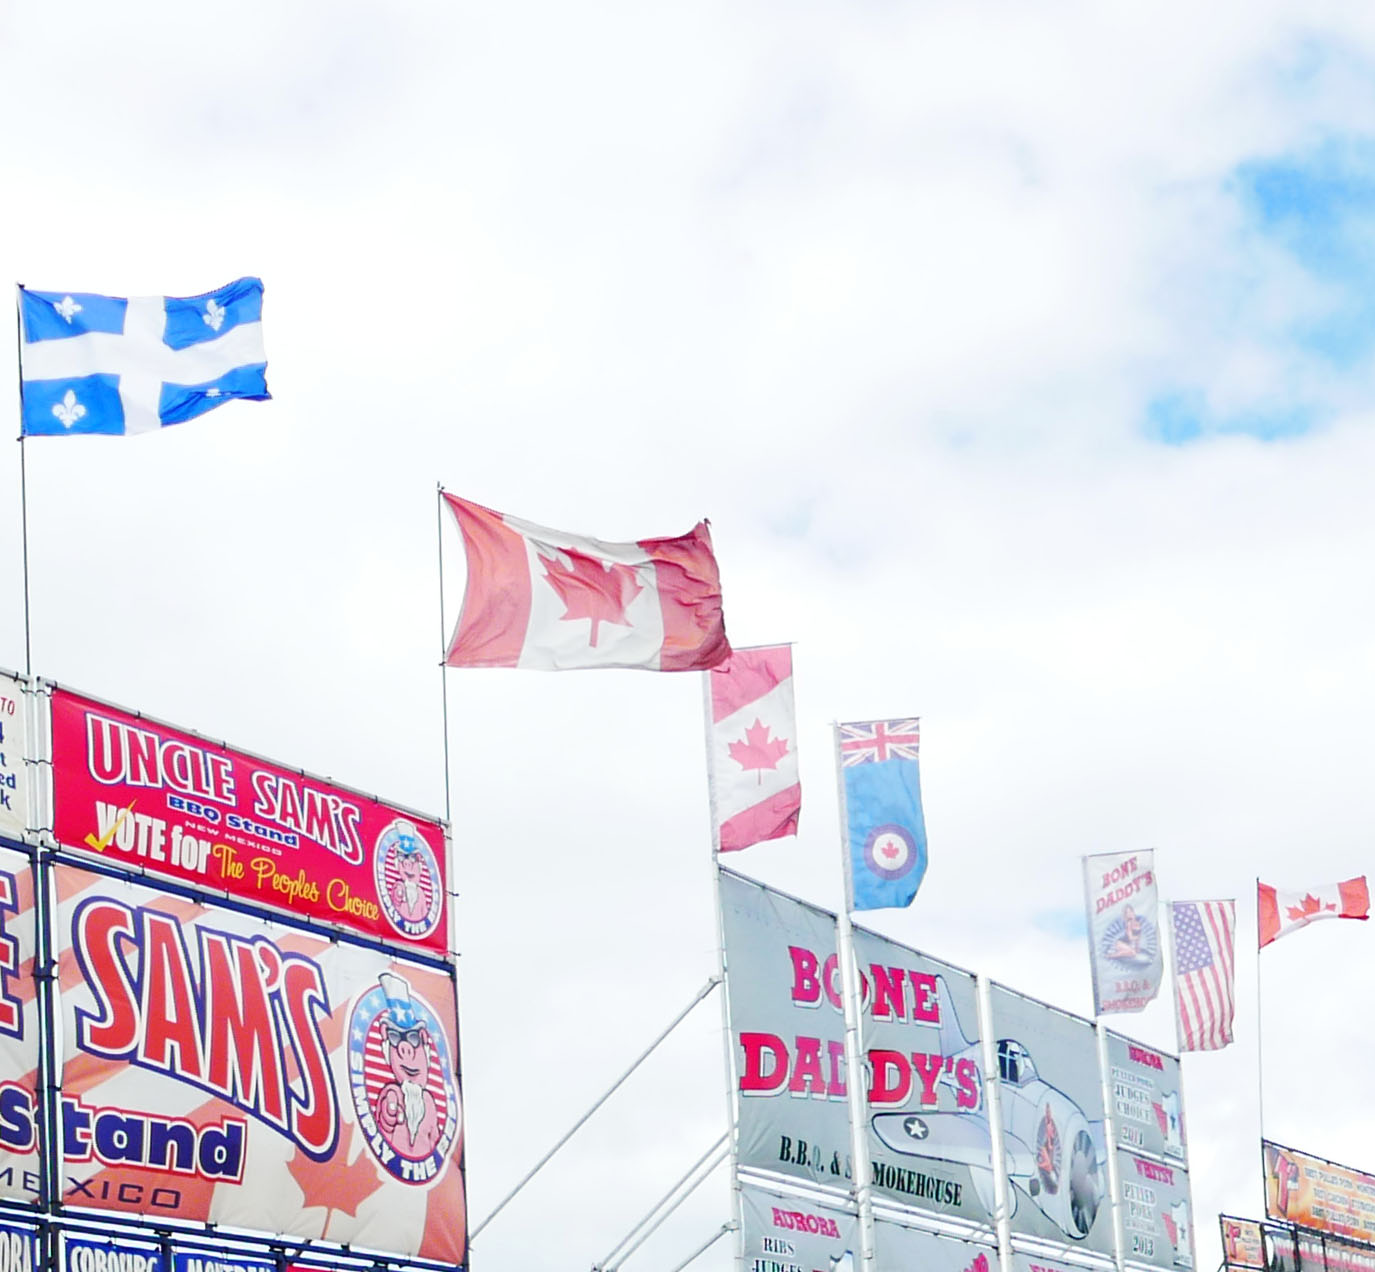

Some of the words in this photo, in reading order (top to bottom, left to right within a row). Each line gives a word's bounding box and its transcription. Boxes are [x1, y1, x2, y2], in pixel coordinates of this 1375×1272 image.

[85, 711, 237, 807] UNCLE
[250, 769, 366, 867] SAM'S
[167, 793, 222, 826] BBQ
[184, 820, 220, 837] NEW
[224, 832, 283, 857] MEXICO
[96, 801, 166, 862] VOTE
[171, 824, 212, 874] for
[250, 857, 320, 904] Peoples
[326, 878, 380, 921] Choice
[1101, 855, 1138, 890] BONE
[1095, 869, 1154, 915] DADDY'S
[788, 944, 942, 1028] BONE
[72, 894, 341, 1165] SAM'S
[738, 1030, 983, 1113] DADDY'S
[400, 1156, 439, 1182] THE
[829, 1148, 841, 1177] &
[771, 1206, 841, 1239] AURORA
[763, 1237, 796, 1257] RIBS
